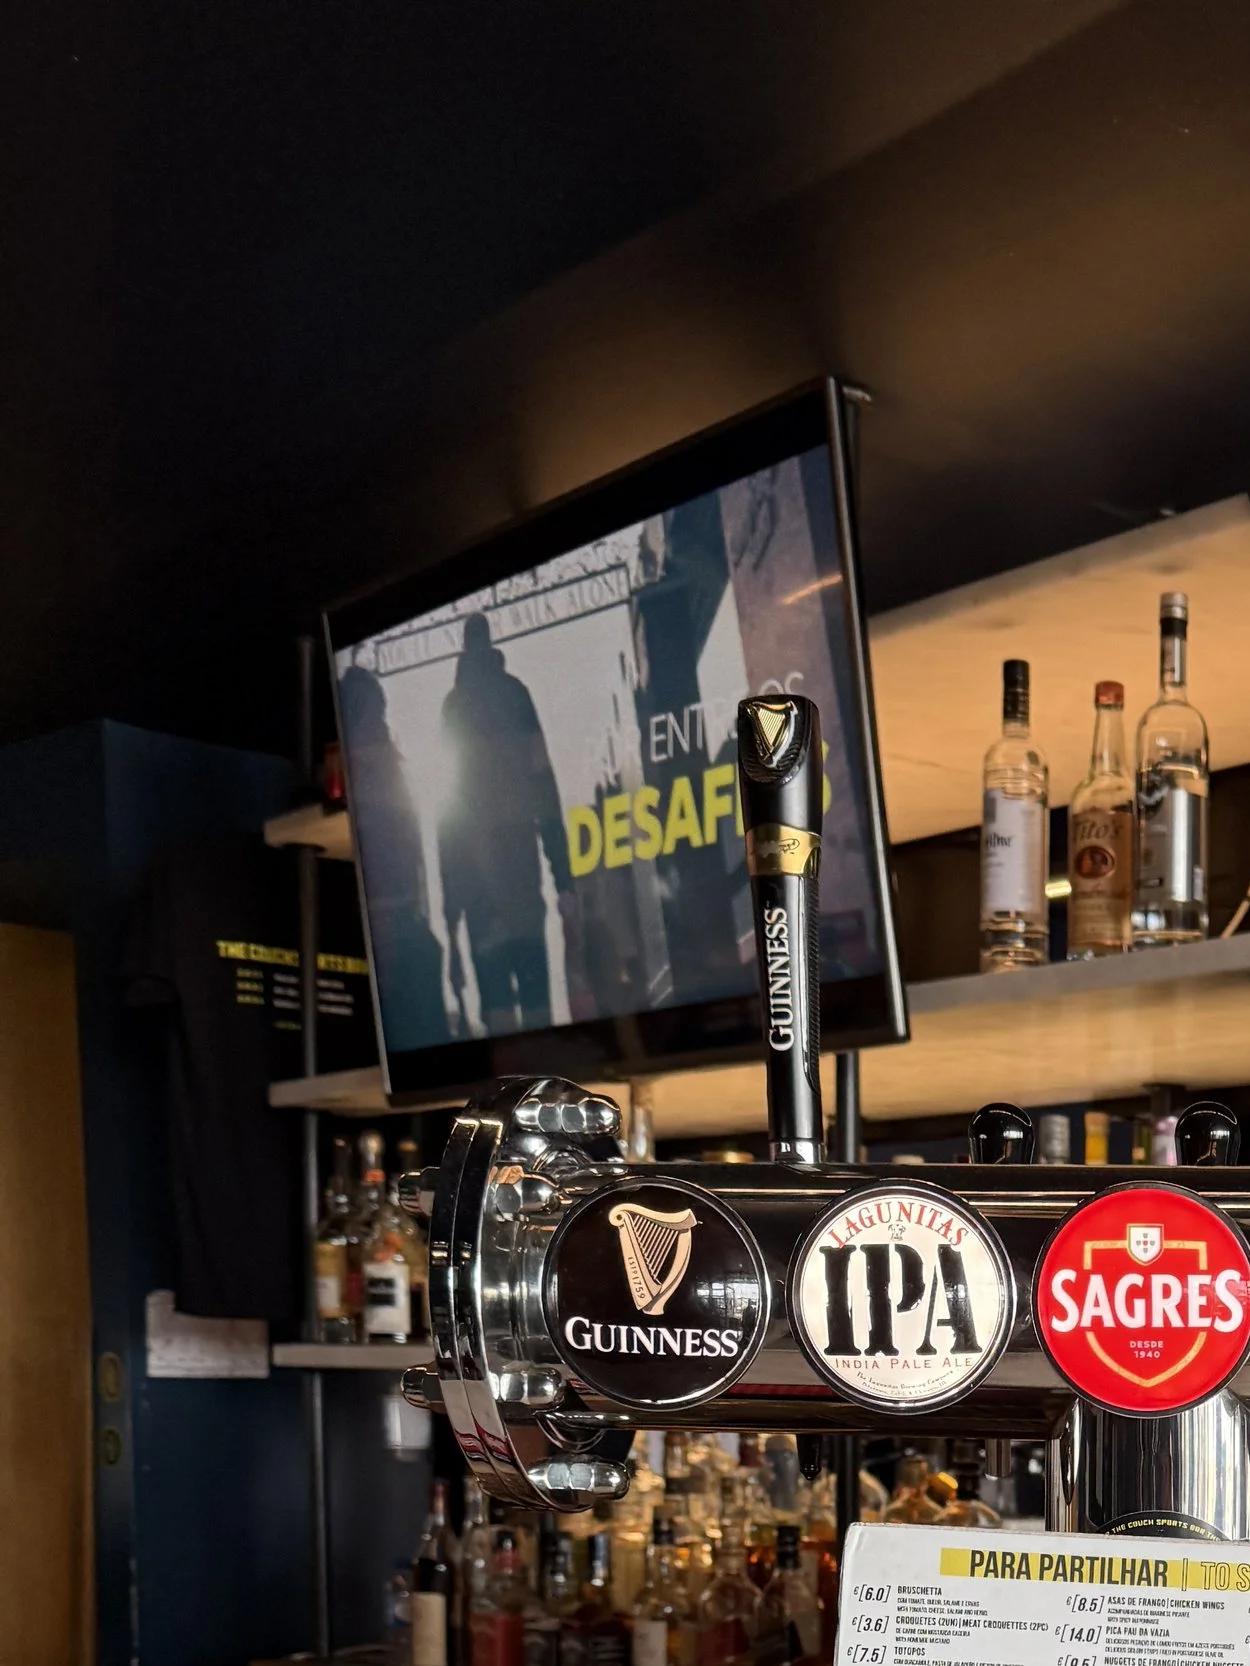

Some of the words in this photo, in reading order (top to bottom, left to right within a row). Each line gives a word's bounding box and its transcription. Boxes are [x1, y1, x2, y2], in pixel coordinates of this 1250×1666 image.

[764, 907, 794, 1051] GUINNESS
[828, 1201, 969, 1248] LAGUNITAS
[631, 1276, 645, 1299] 1759
[819, 1243, 983, 1356] IPA
[1051, 1269, 1243, 1333] SAGRES
[565, 1316, 739, 1357] GUINNESS
[1130, 1340, 1164, 1349] DESDE
[835, 1358, 880, 1369] INDIA
[891, 1357, 931, 1369] PALE
[942, 1357, 973, 1368] ALE
[1134, 1350, 1160, 1359] 1940
[1112, 1524, 1126, 1535] THE
[1127, 1519, 1154, 1529] COUCH
[1156, 1519, 1188, 1529] SPORTS
[970, 1549, 1031, 1581] PARA
[1039, 1554, 1168, 1587] PARTILHAR
[1201, 1561, 1230, 1590] TO
[897, 1585, 942, 1595] BRUSCHETTA
[1105, 1625, 1121, 1634] PICA
[1123, 1626, 1137, 1635] PAU
[1138, 1627, 1148, 1636] DA
[1150, 1628, 1170, 1637] VAZIA
[894, 1646, 925, 1655] TOTOPOS
